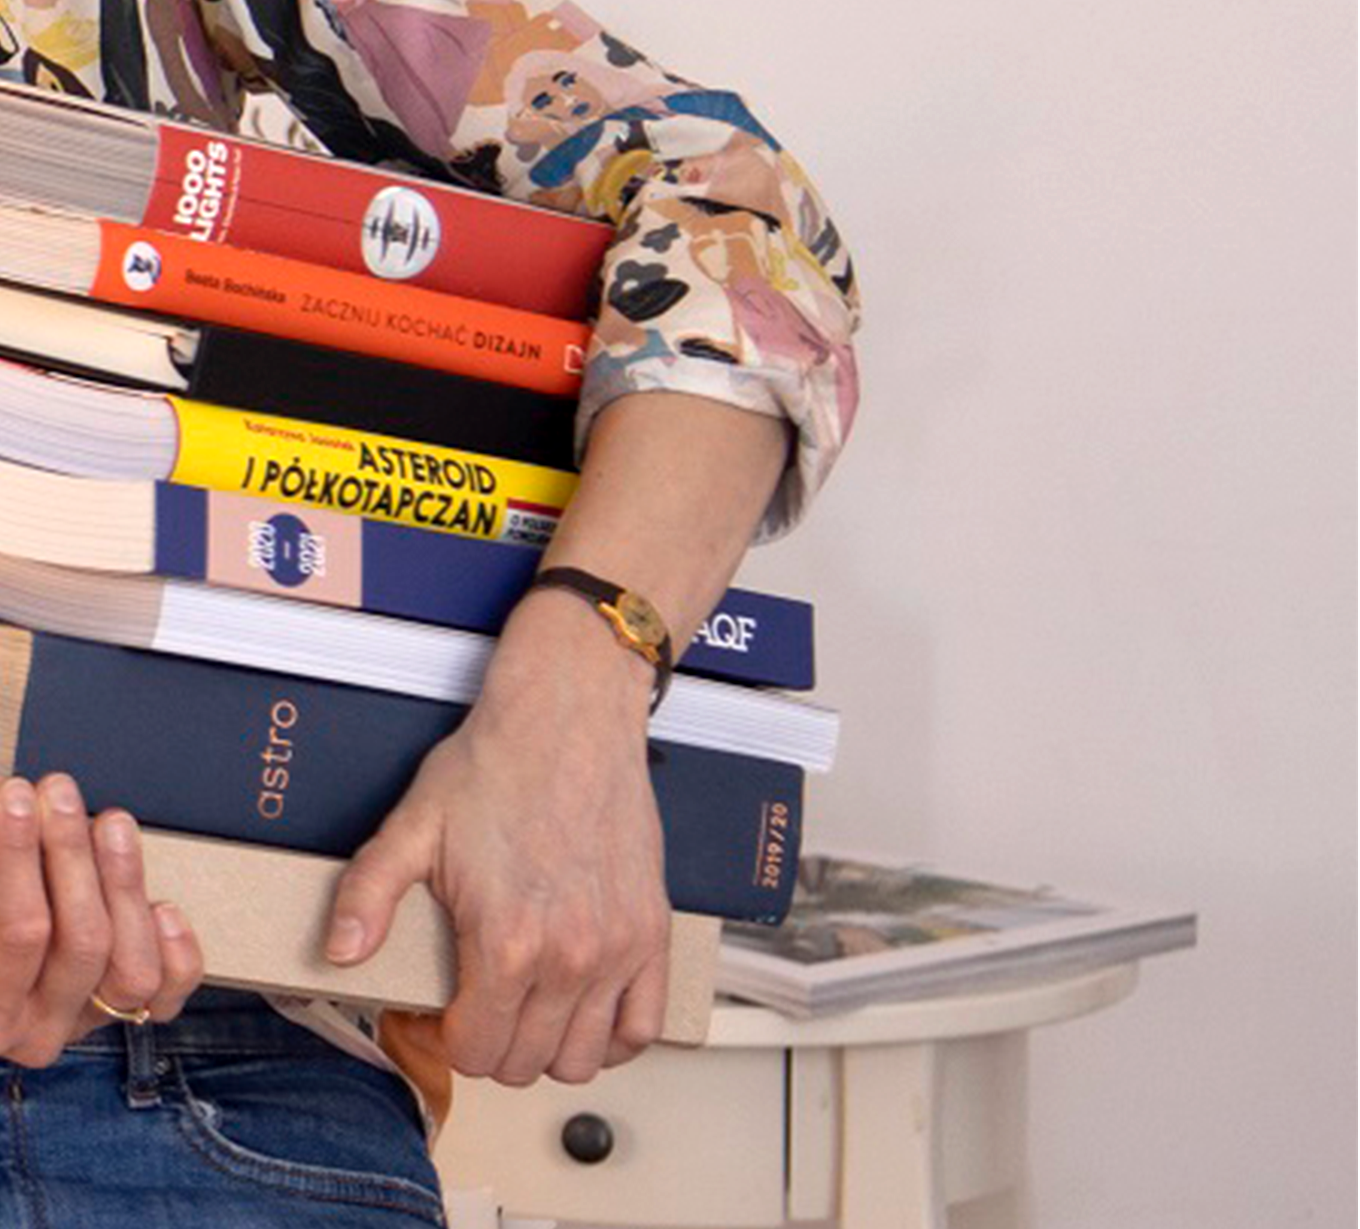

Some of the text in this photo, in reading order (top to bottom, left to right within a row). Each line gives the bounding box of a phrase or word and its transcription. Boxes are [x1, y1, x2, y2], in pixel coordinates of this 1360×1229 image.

[189, 141, 228, 242] LIGHTS
[384, 313, 468, 346] KOCHAĆ
[472, 331, 542, 360] DIZAJN
[259, 456, 498, 537] PÓŁKOTAPCZAN
[358, 442, 497, 495] ASTEROID
[257, 699, 298, 820] astro
[762, 803, 788, 888] 2019/20
